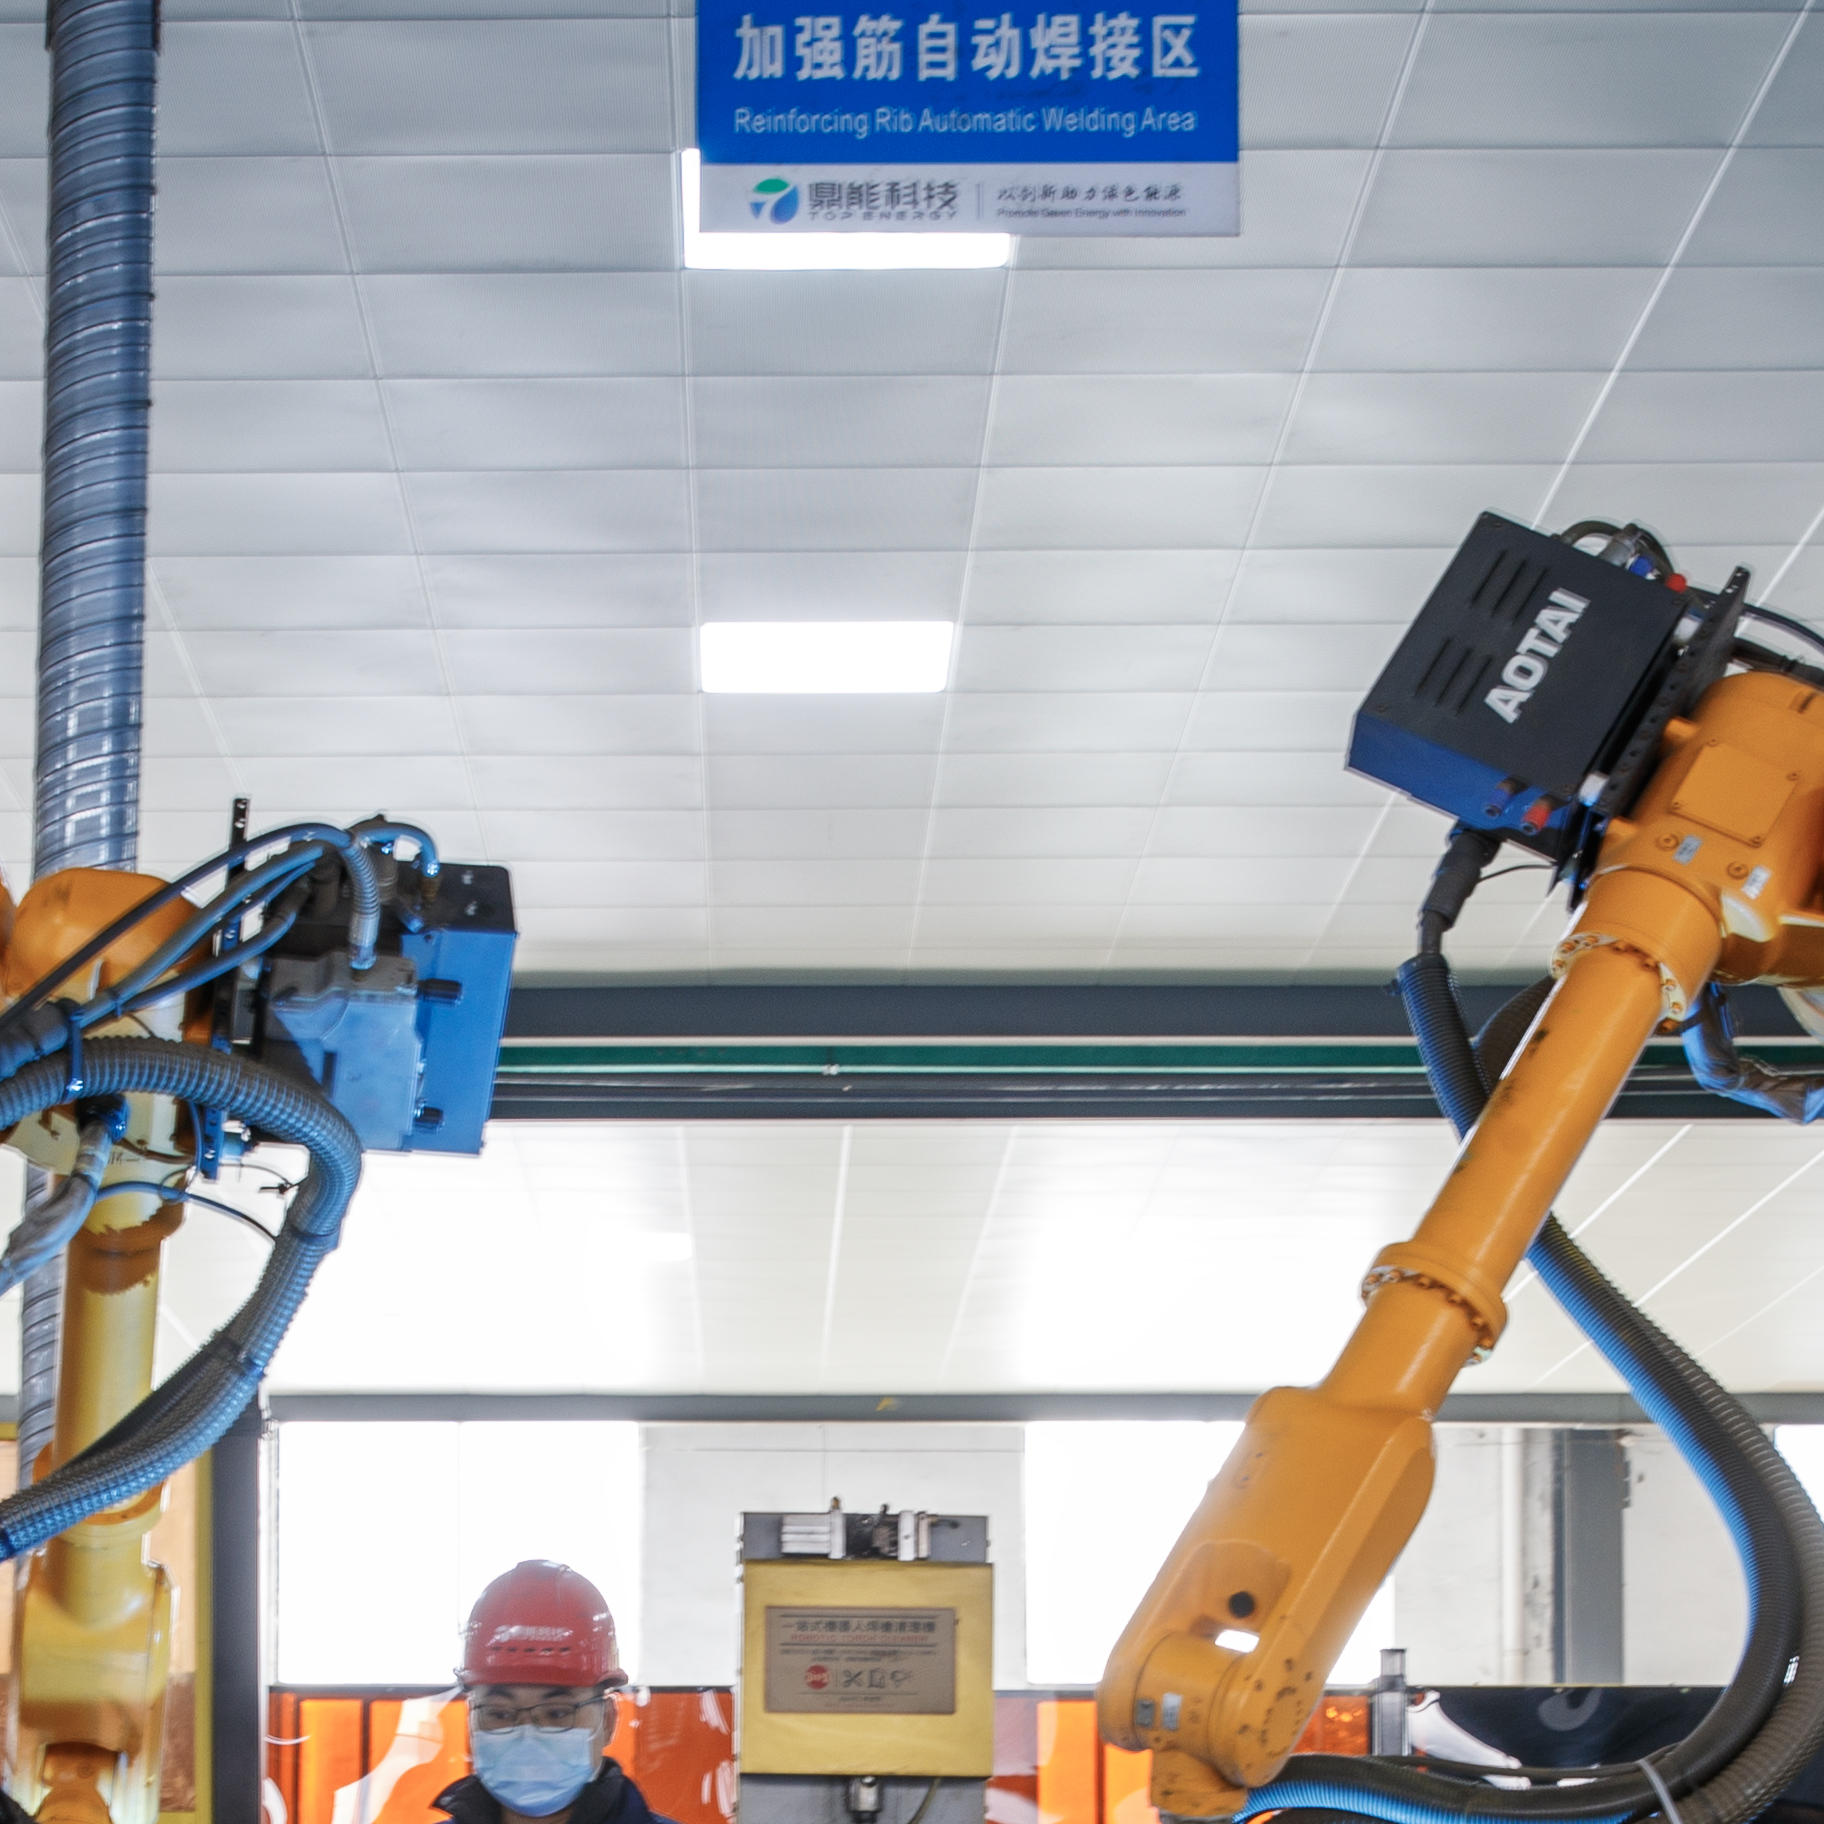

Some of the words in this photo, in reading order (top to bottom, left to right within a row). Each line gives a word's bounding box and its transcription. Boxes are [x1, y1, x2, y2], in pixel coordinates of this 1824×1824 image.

[733, 13, 1202, 82] 加强筋自动焊接区
[734, 106, 870, 140] Reinforcing
[875, 107, 914, 133] Rib
[918, 107, 1036, 133] Automatic
[1042, 106, 1136, 138] Welding
[1140, 106, 1196, 132] Area
[808, 182, 959, 210] 鼎能科技
[808, 210, 853, 222] TOP
[863, 210, 957, 222] ENERGY
[1484, 587, 1591, 723] AOTAI
